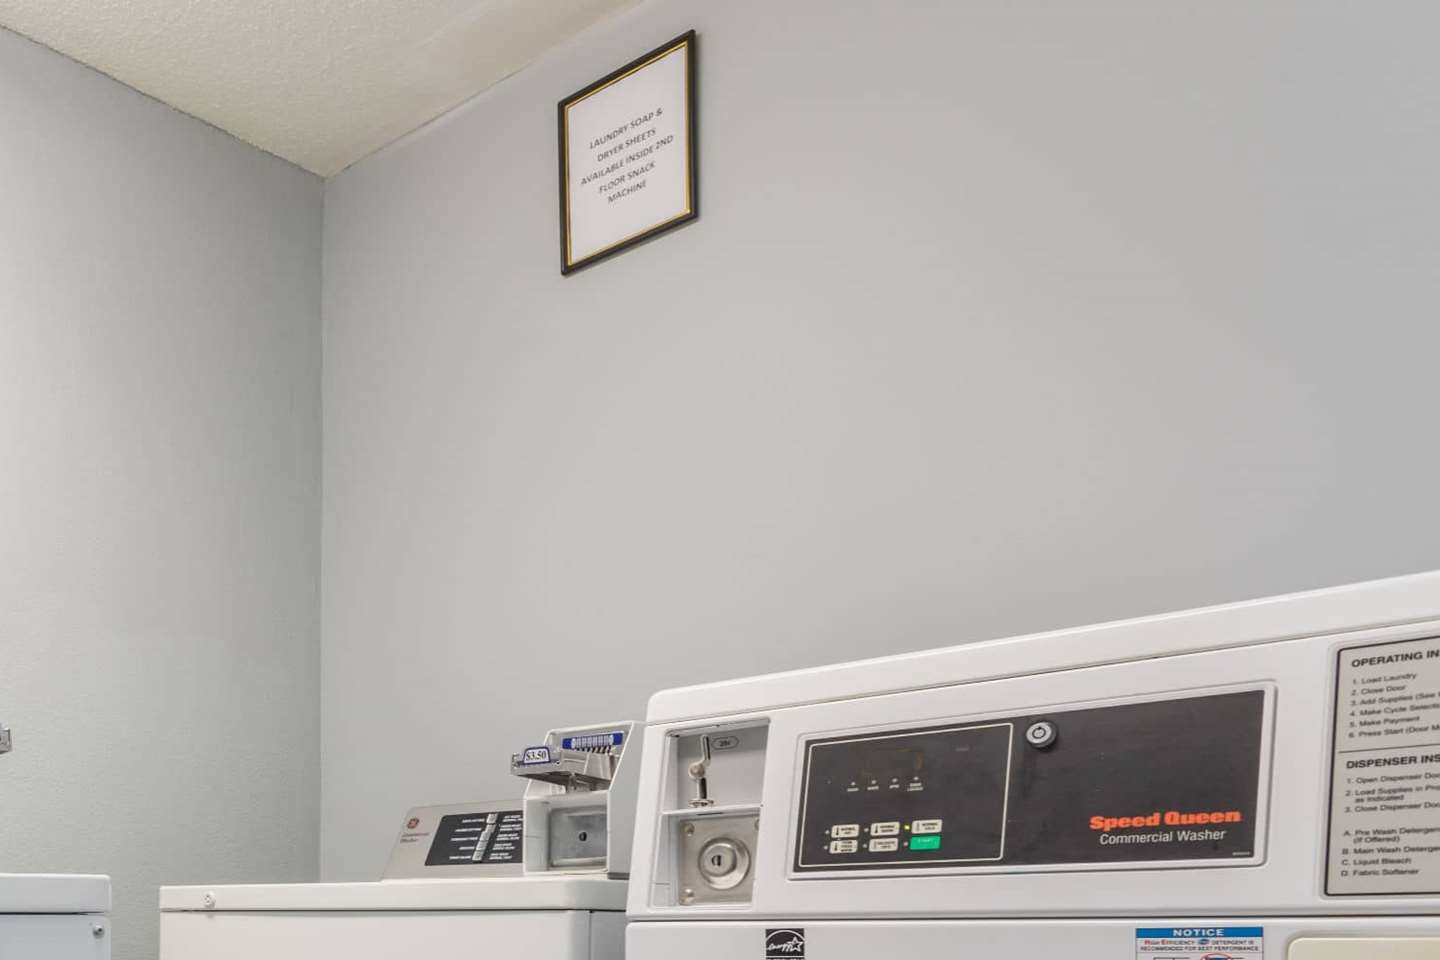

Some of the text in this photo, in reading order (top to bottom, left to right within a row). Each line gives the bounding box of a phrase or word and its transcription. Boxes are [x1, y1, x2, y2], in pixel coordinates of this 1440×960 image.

[590, 107, 663, 149] LAUNDRY SOAP &
[597, 127, 657, 163] DRYER SHEETS
[580, 134, 674, 186] AVAILABLE INSIDE 2ND
[599, 161, 656, 194] FLOOR SNACK
[608, 179, 646, 202] MACHINE
[1351, 652, 1423, 667] OPERATING
[1346, 756, 1417, 769] DISPENSER
[1090, 811, 1242, 831] Speed Queen
[1100, 830, 1226, 845] Commercial Washer
[1172, 928, 1225, 937] NOTICE
